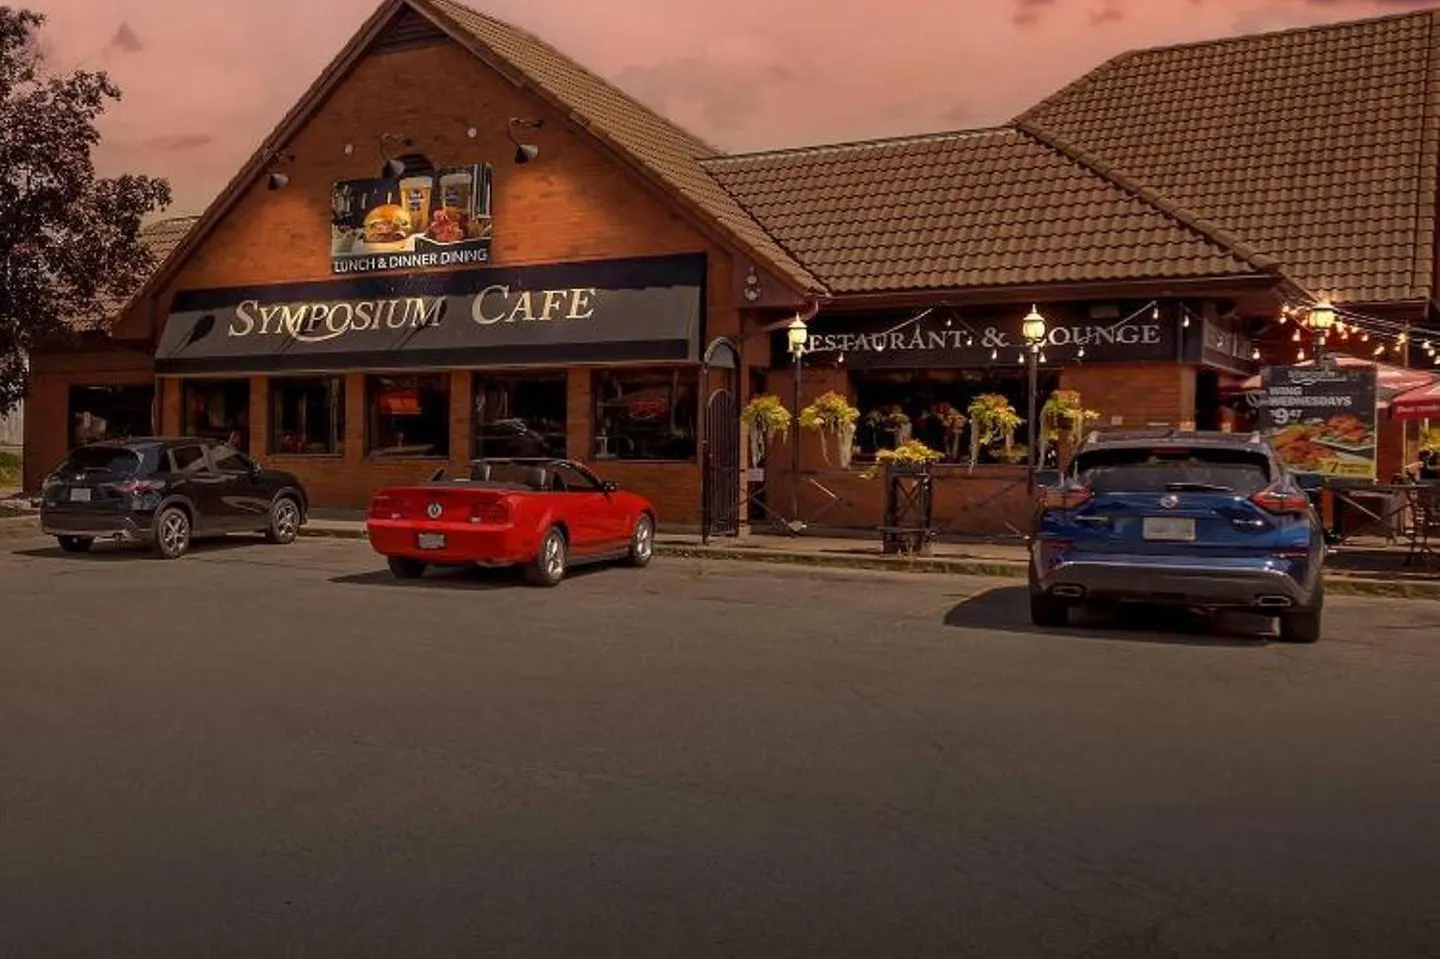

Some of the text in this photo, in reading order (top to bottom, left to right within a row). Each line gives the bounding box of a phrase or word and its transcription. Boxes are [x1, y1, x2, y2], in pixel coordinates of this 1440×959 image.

[334, 247, 487, 273] LUNCH & DINNER DINING
[227, 284, 597, 342] SYMPOSIUM CAFE
[980, 326, 1010, 348] &
[1268, 395, 1353, 407] WEDNESDAYS
